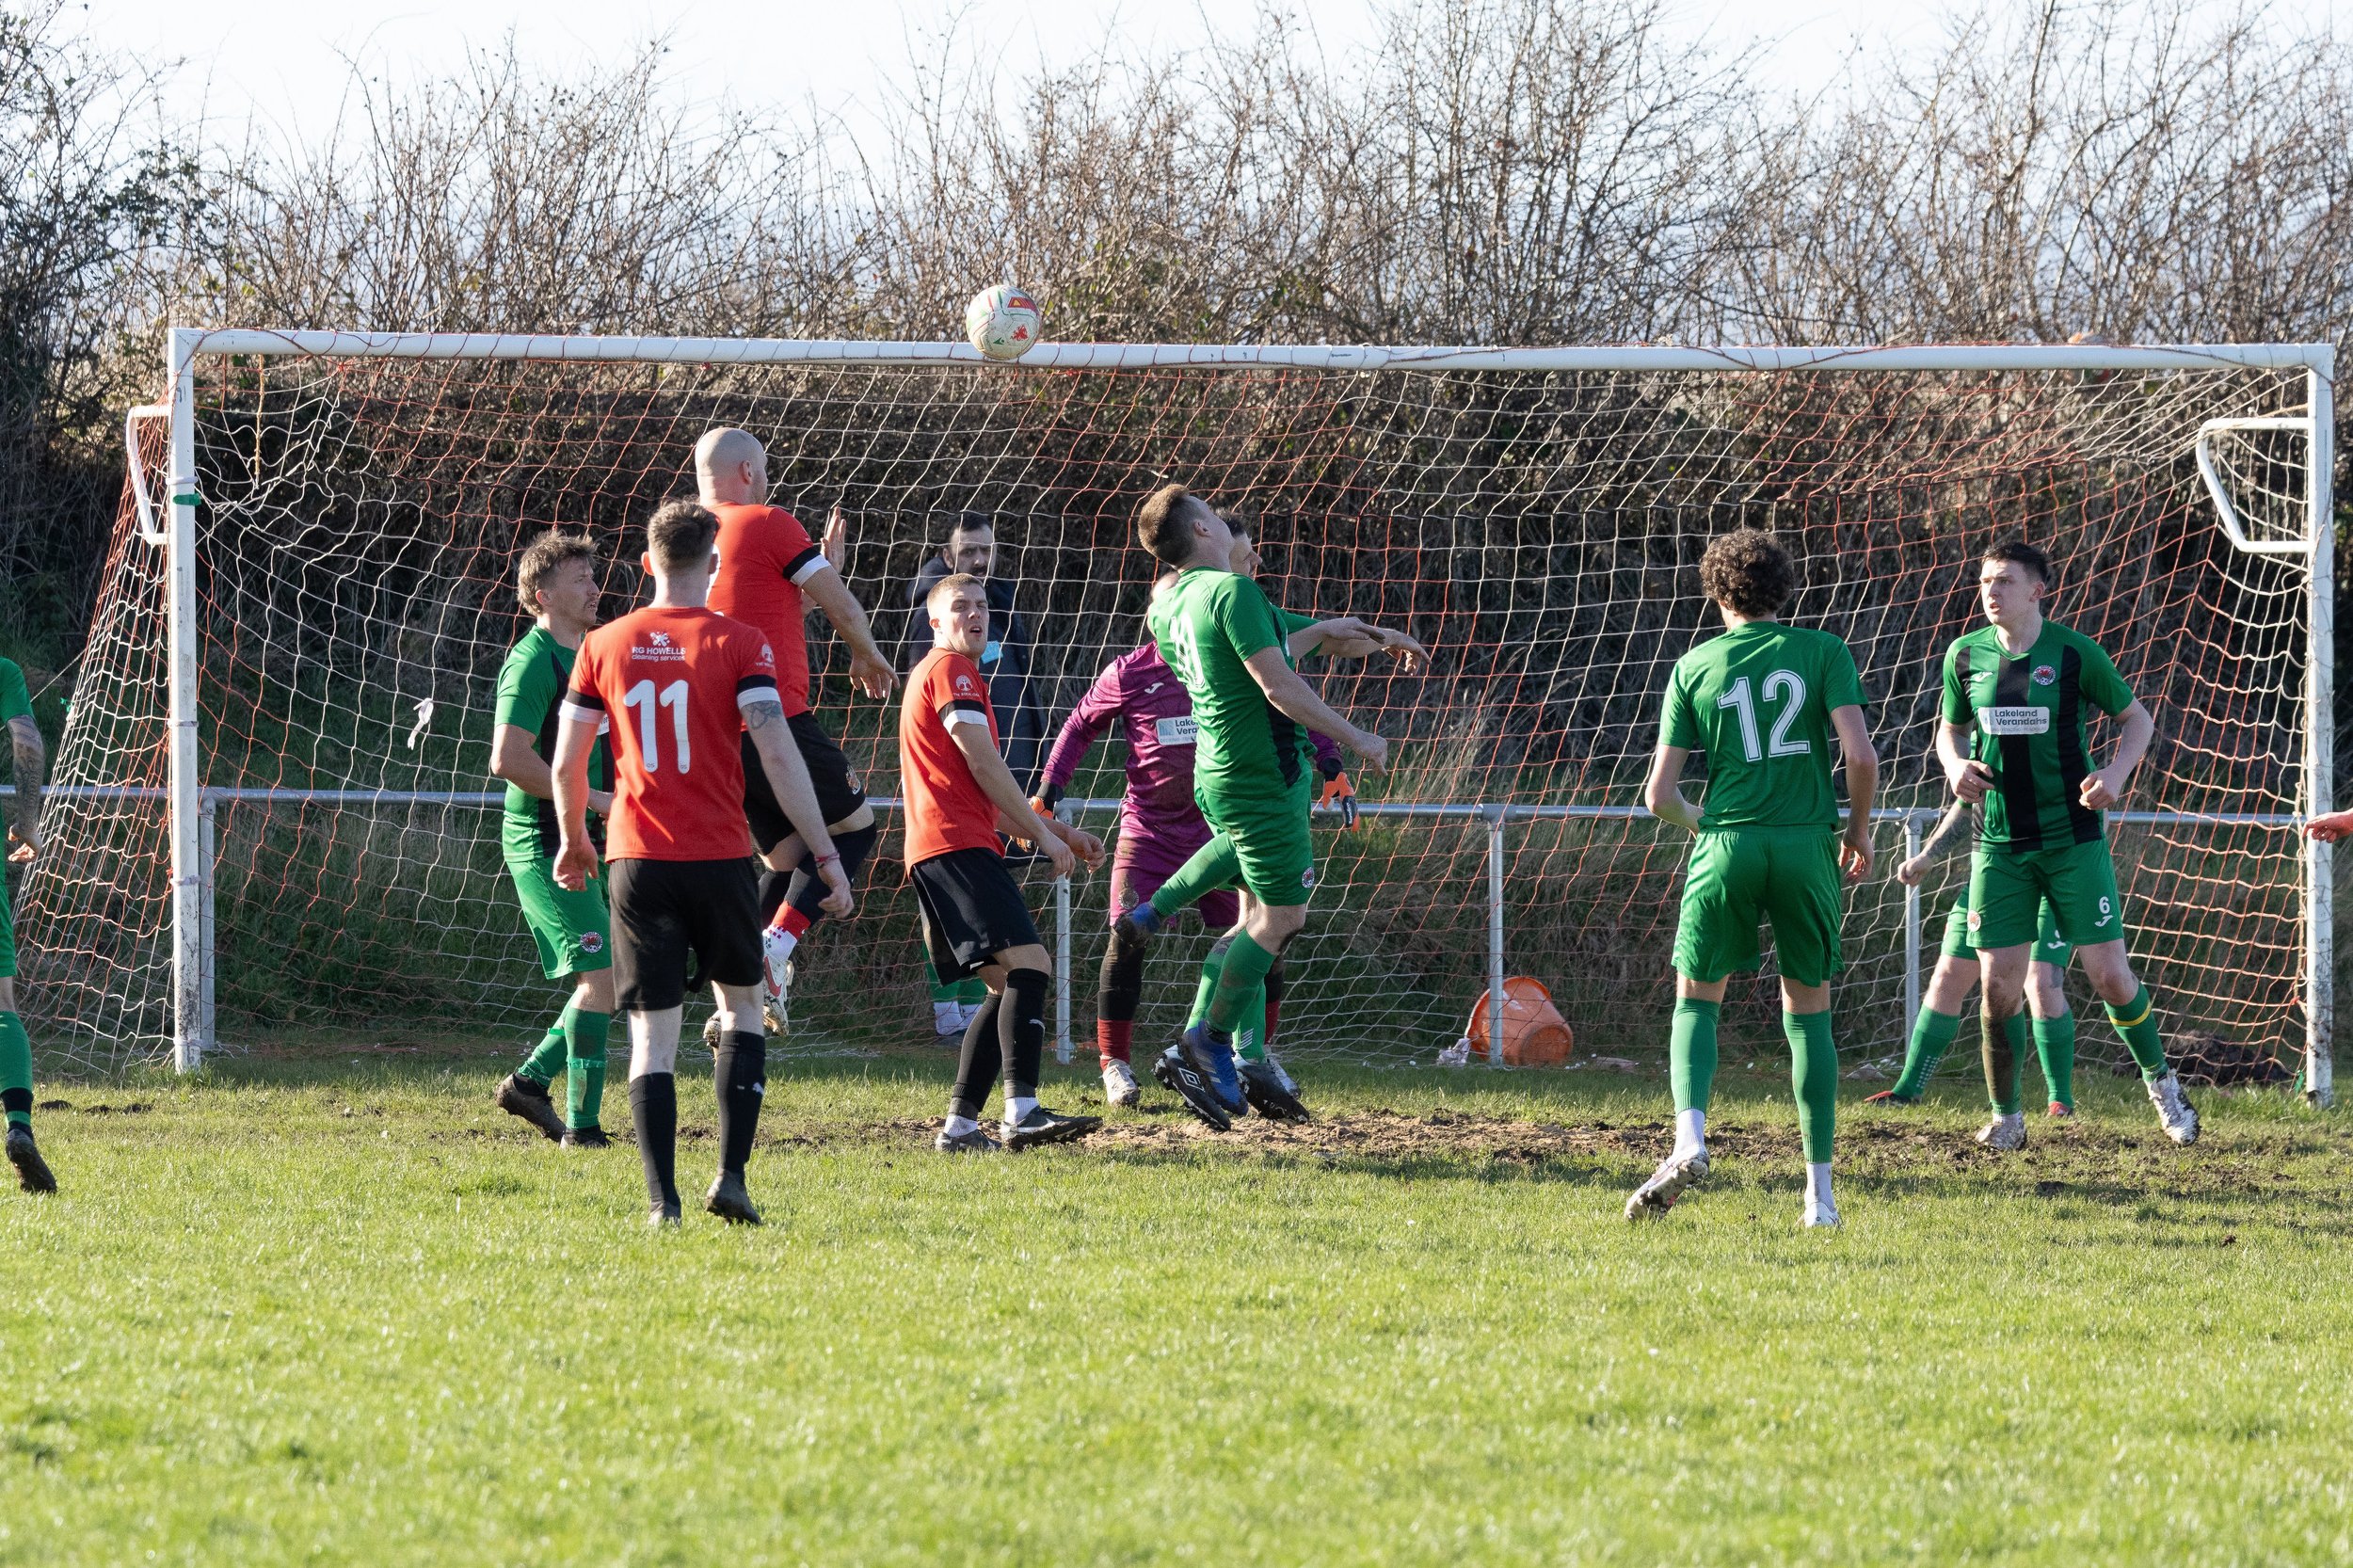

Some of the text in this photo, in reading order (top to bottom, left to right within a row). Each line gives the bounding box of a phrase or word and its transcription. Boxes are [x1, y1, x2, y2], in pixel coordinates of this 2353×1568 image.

[647, 647, 686, 655] HOWELLS
[1717, 669, 1811, 762] 12
[1175, 718, 1198, 728] Lake
[1995, 717, 2047, 726] Verandahs
[623, 680, 691, 775] 11
[1176, 727, 1199, 735] Vera
[2099, 896, 2110, 914] 6
